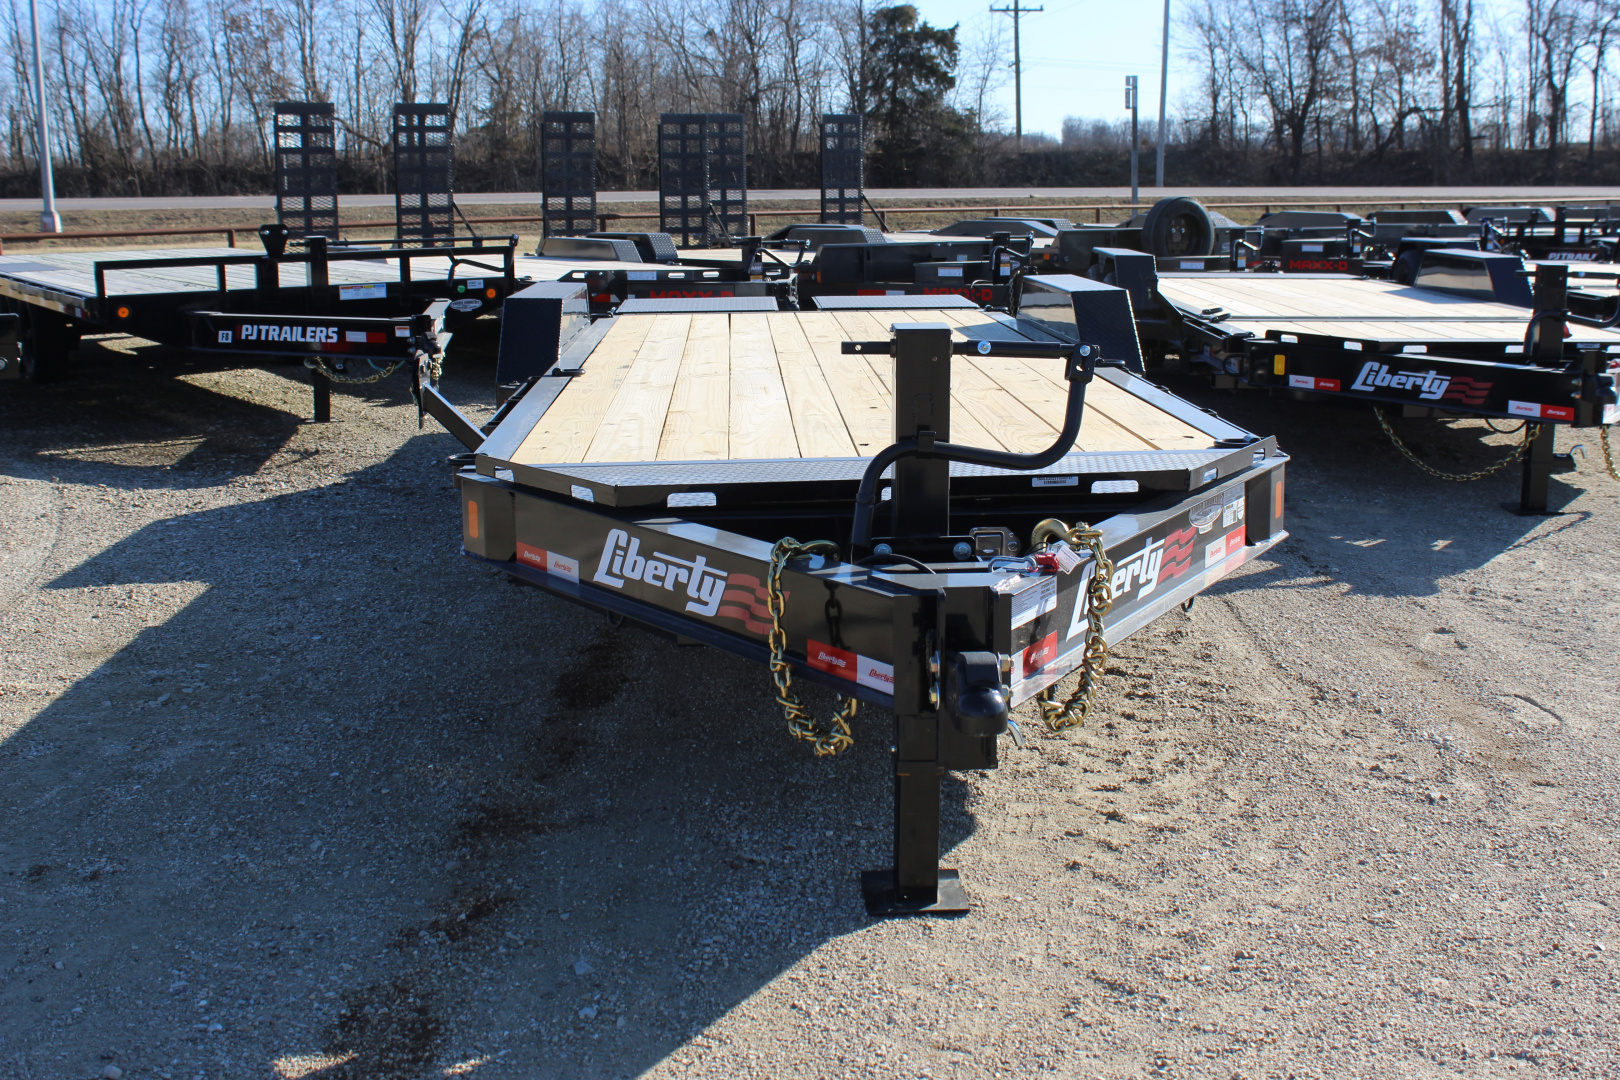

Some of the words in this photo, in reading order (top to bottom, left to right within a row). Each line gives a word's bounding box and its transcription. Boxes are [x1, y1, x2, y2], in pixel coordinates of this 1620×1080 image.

[1289, 260, 1348, 271] MAXX-D
[240, 324, 258, 341] PJ
[258, 324, 339, 343] TRAILERS
[1350, 361, 1451, 400] Liberty
[593, 528, 728, 617] Liberty
[1066, 536, 1166, 641] Lerty
[817, 651, 839, 666] Liberty
[868, 668, 890, 683] Liberty
